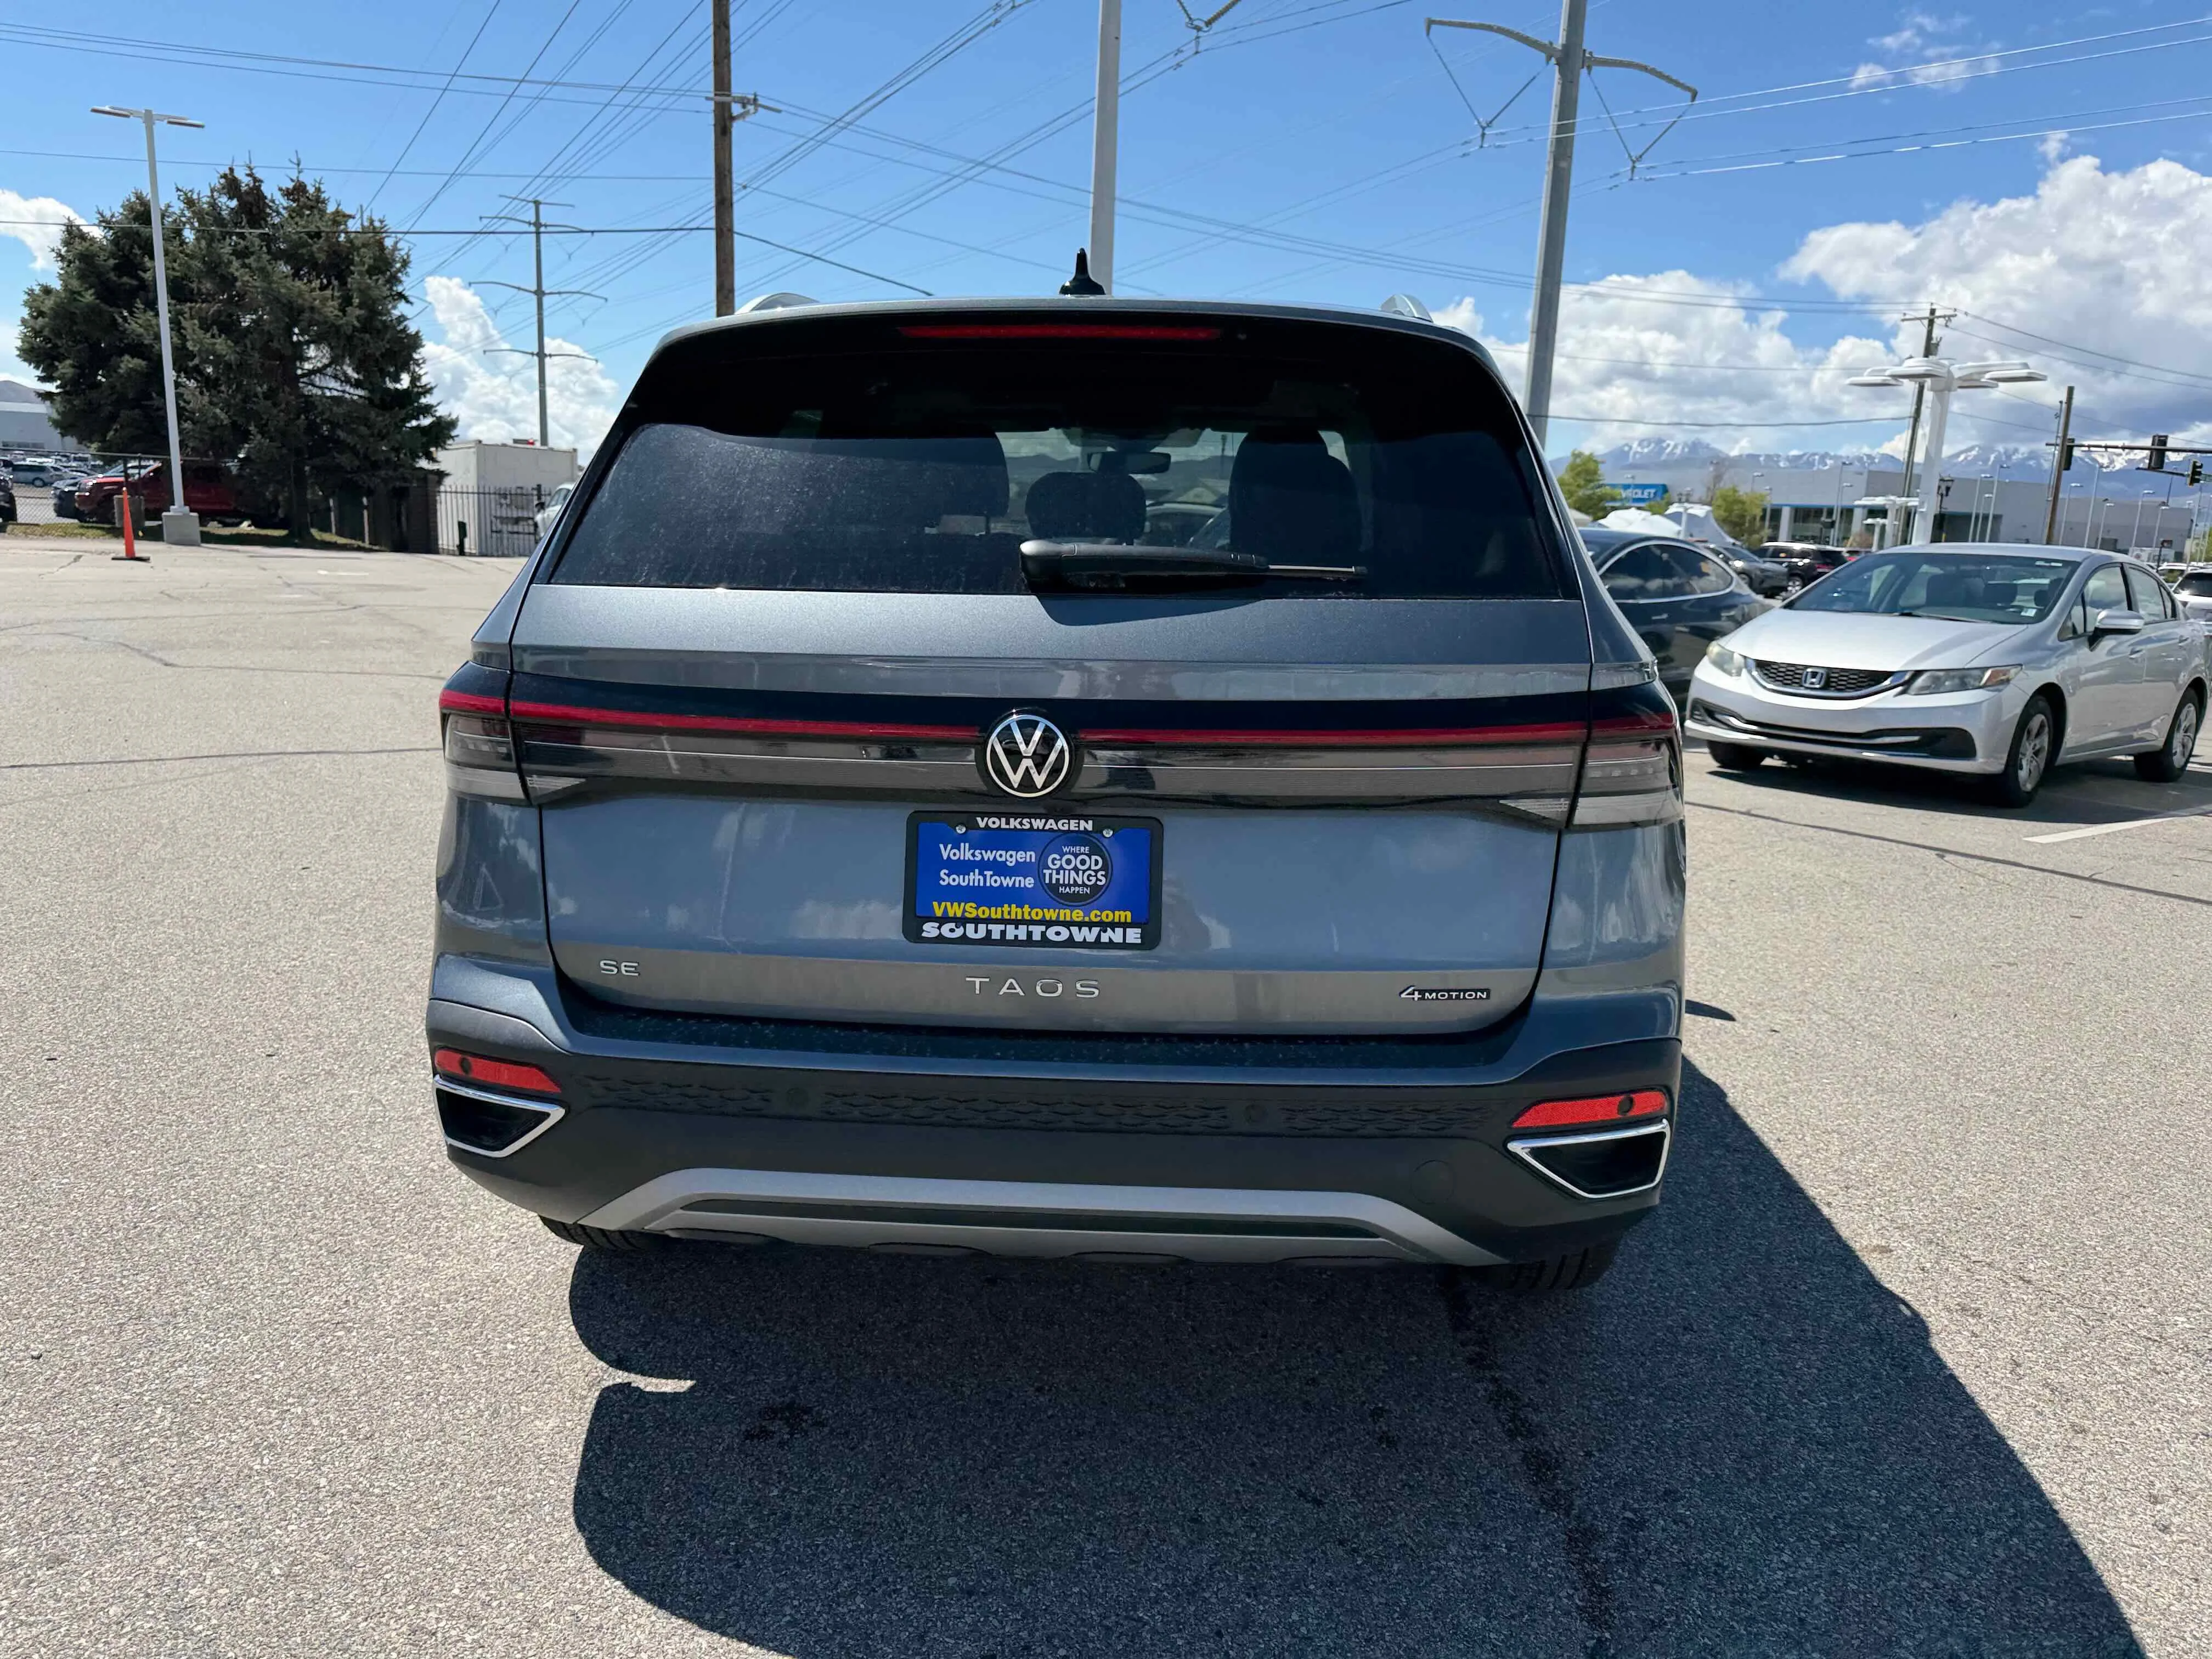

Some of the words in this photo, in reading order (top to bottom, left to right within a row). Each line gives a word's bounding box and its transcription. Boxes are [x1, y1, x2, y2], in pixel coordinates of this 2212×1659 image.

[977, 817, 1093, 831] VOLKSWAGEN
[939, 843, 1035, 866] Volkswagen
[1047, 854, 1103, 870] GOOD
[1043, 869, 1107, 885] THINGS
[1059, 885, 1090, 894] HAPPEN
[933, 901, 1132, 923] VWSouthtowne.com
[921, 922, 1142, 944] SOUTHTOWNE
[600, 960, 639, 976] SE
[965, 977, 1100, 998] TAOS
[1400, 986, 1487, 1001] 4MOTION
